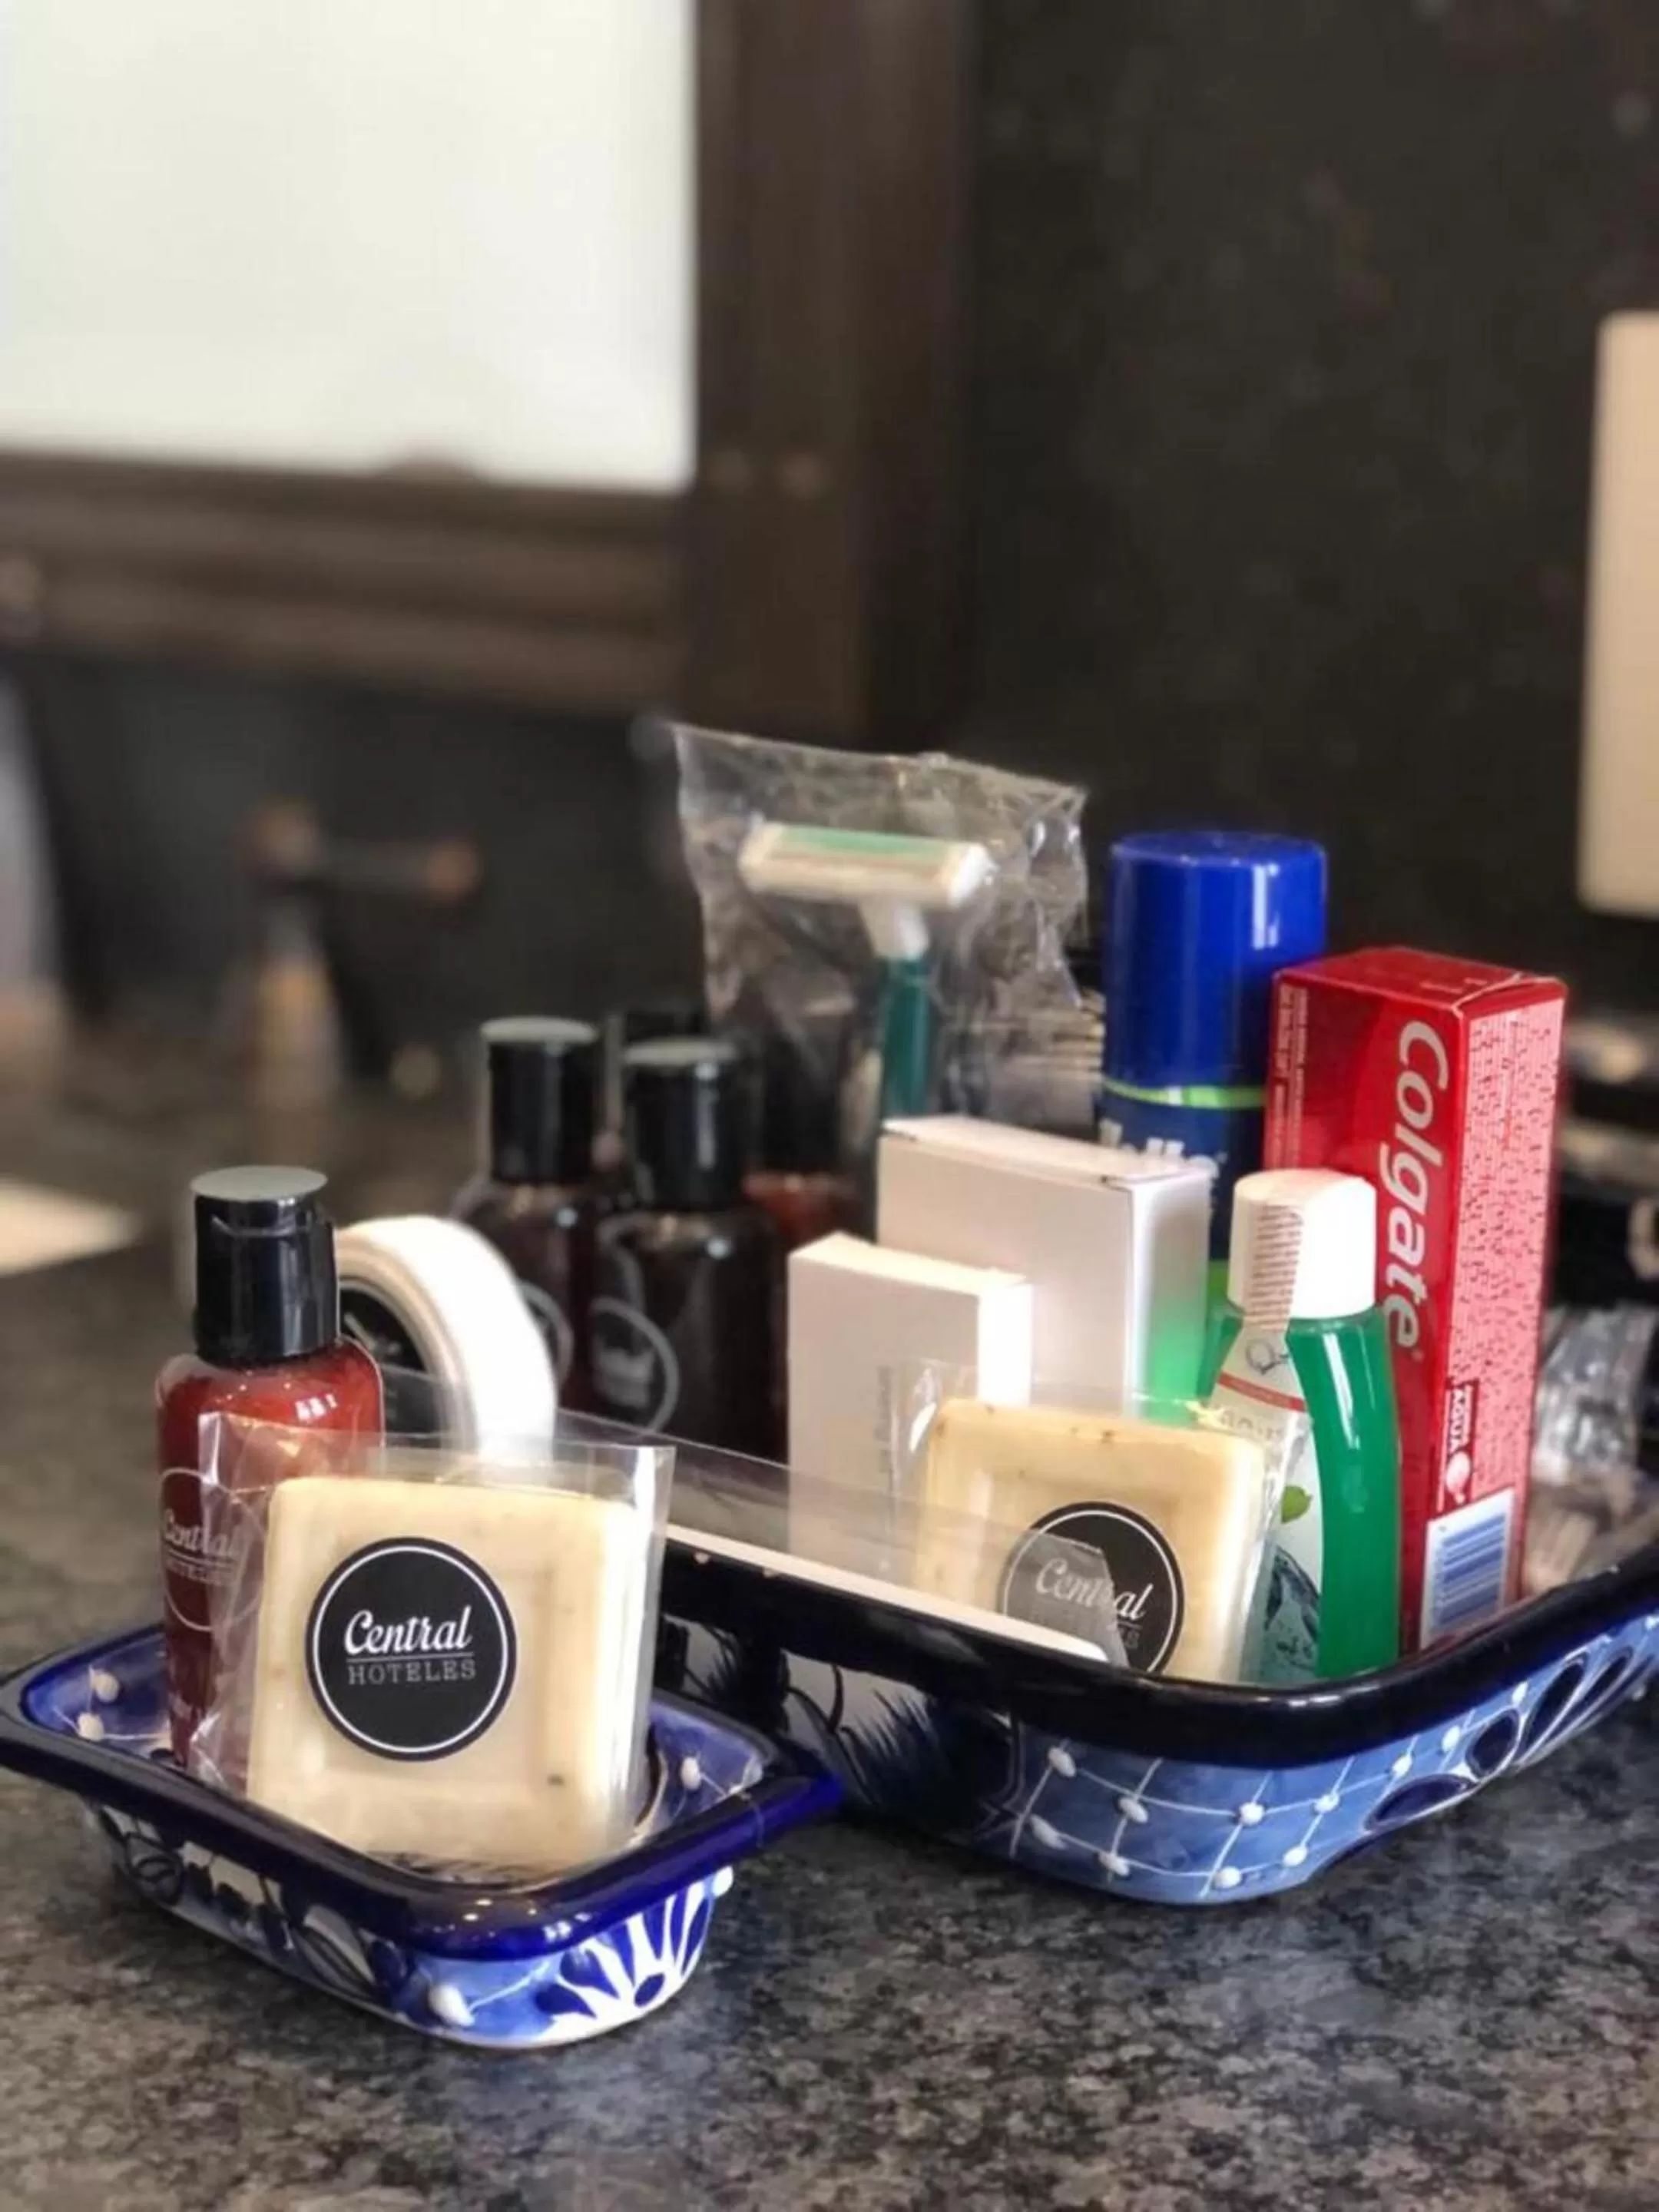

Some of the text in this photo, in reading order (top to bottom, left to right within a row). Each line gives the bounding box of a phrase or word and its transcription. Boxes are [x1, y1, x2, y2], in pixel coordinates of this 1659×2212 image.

[1379, 1021, 1450, 1348] Colgate
[163, 1508, 239, 1558] Cental
[344, 1604, 474, 1656] Central
[348, 1658, 477, 1686] HOTELES
